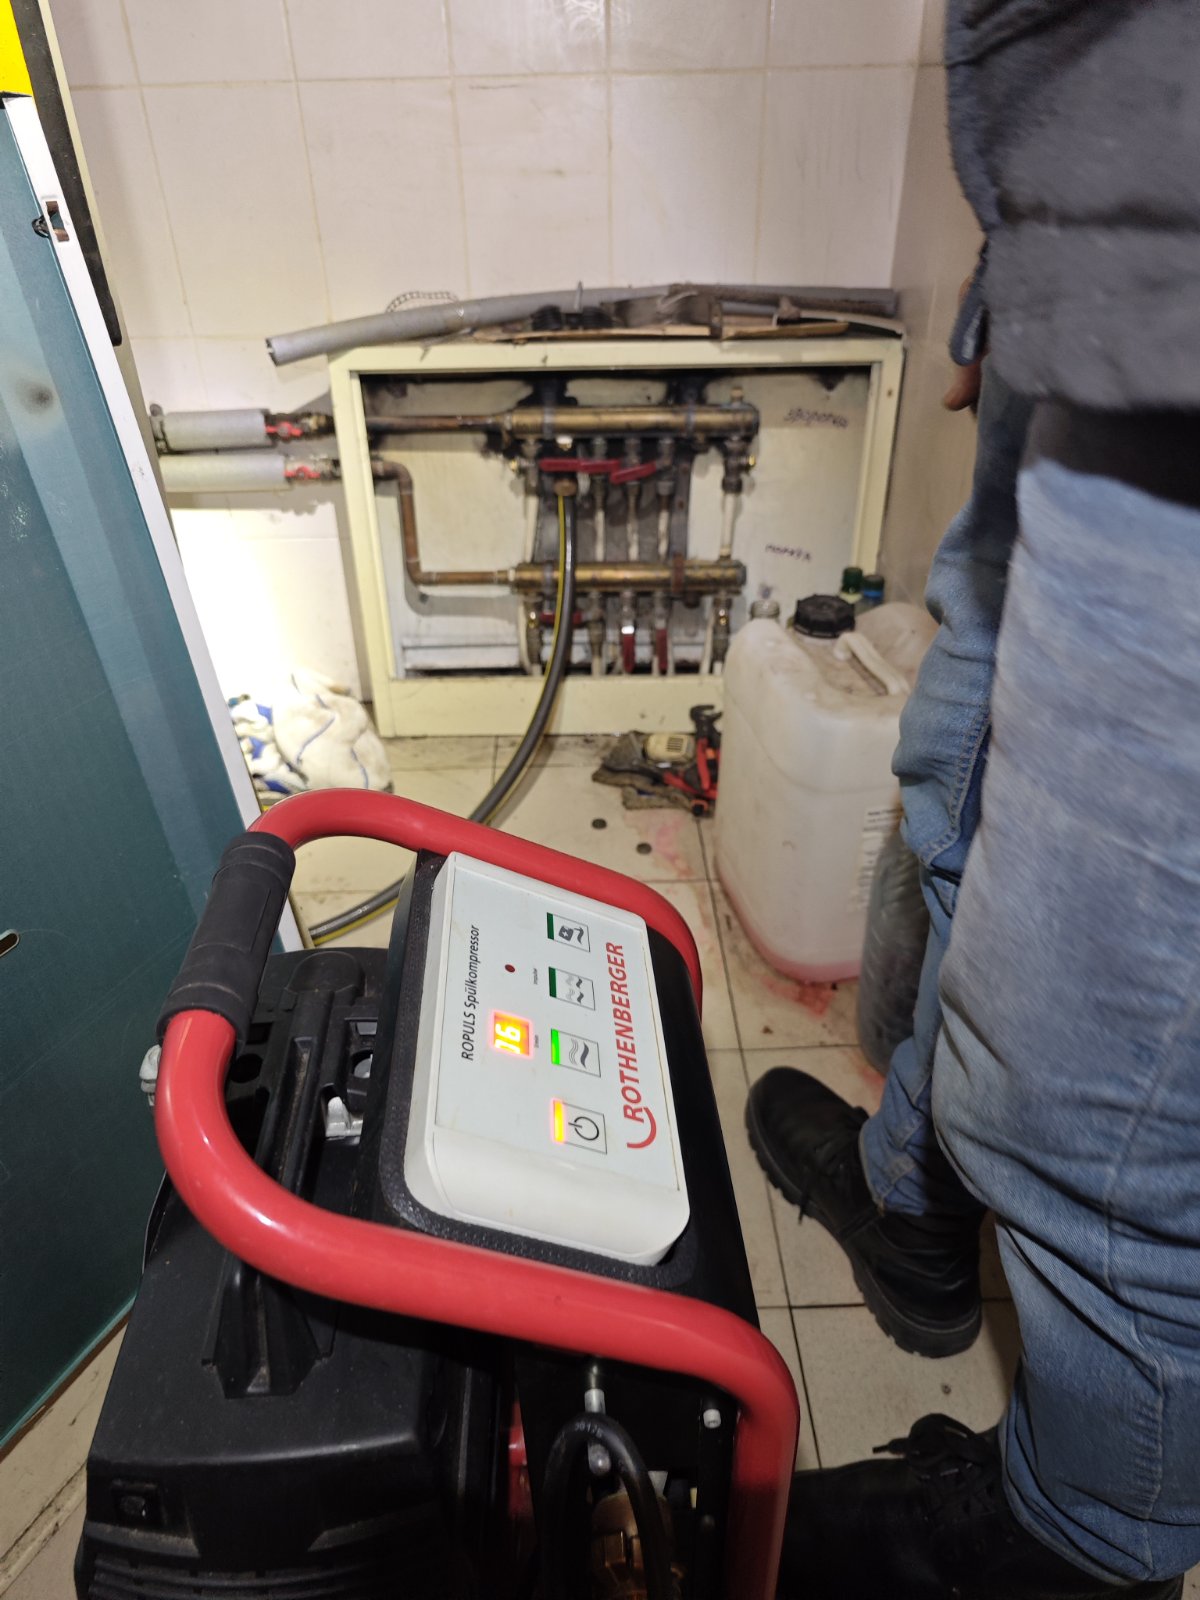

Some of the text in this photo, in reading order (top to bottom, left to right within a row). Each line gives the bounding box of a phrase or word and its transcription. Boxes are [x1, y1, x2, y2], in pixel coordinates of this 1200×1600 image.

[461, 925, 481, 1061] ROPULS Spülkompressor
[605, 942, 645, 1124] ROTHENBERGER
